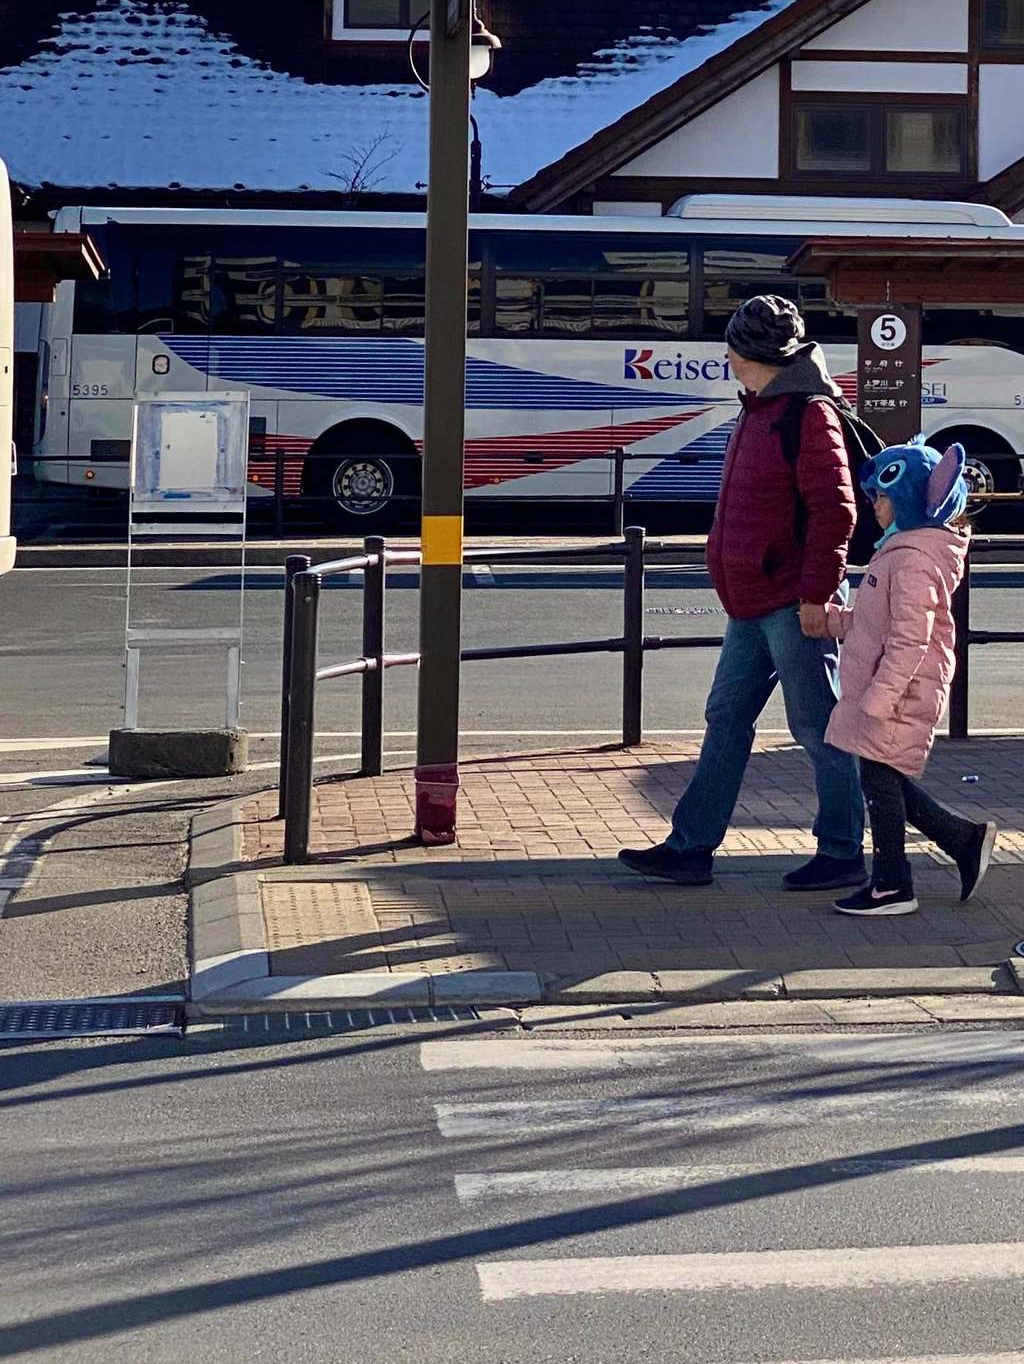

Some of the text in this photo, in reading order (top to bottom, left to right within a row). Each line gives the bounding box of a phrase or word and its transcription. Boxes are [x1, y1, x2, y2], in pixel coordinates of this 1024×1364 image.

[880, 317, 896, 341] 5
[624, 349, 730, 381] Keisei
[73, 384, 108, 396] 5395
